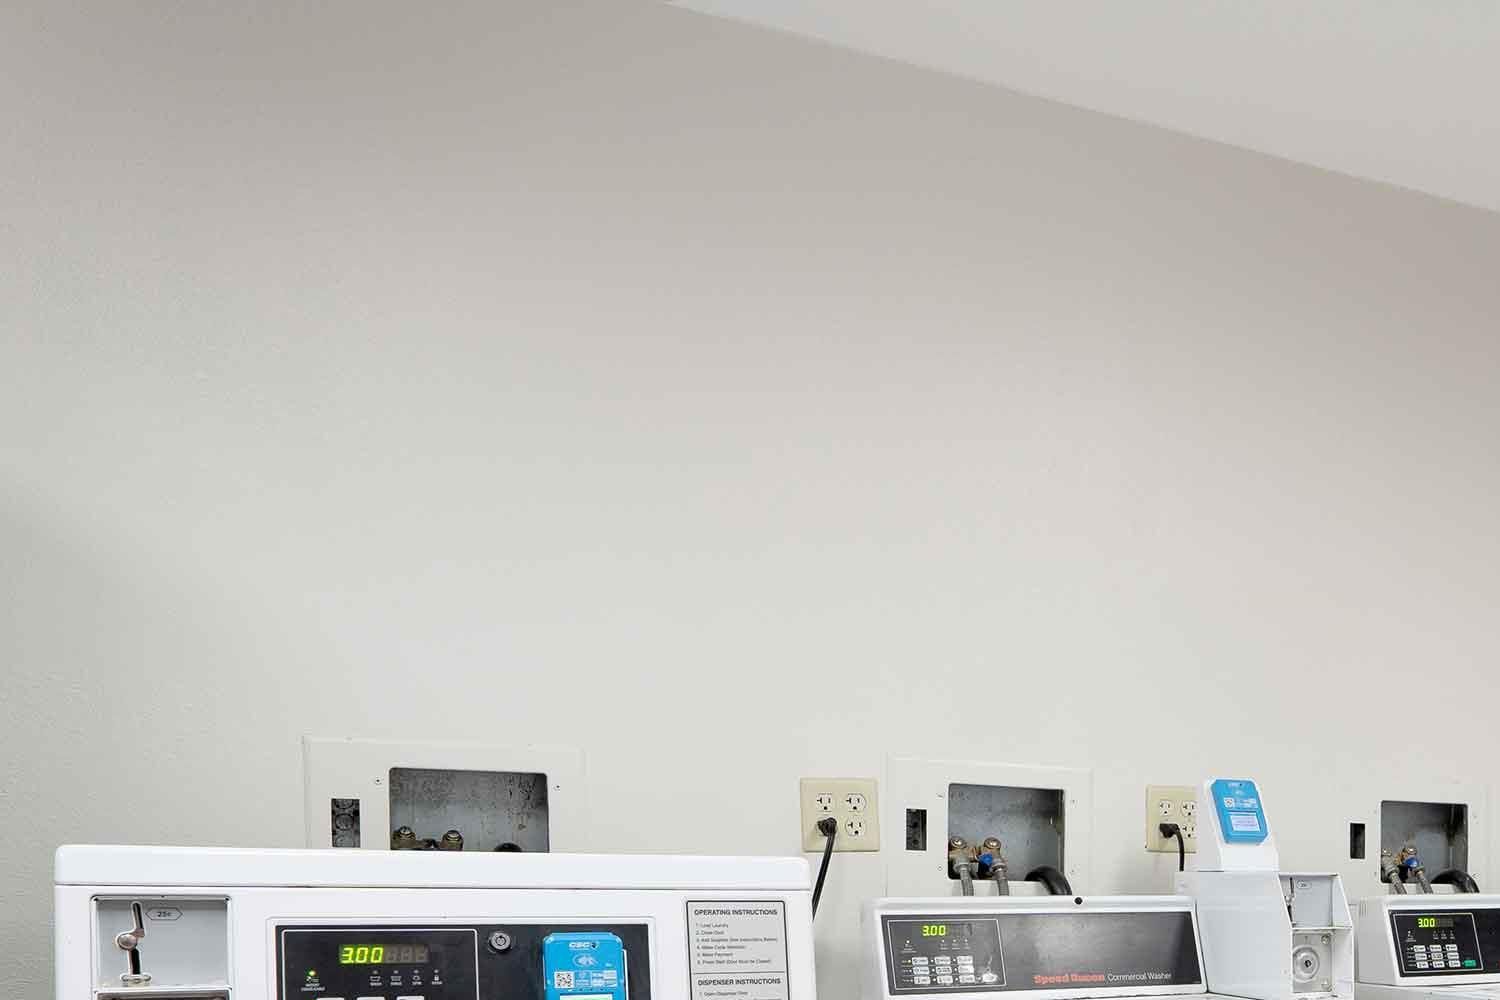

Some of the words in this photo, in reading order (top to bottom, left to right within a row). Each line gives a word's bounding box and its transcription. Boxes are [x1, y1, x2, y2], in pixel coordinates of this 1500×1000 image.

[922, 925, 946, 937] 3.00
[340, 946, 384, 964] 3.00
[735, 977, 781, 985] INSTRUCTIONS
